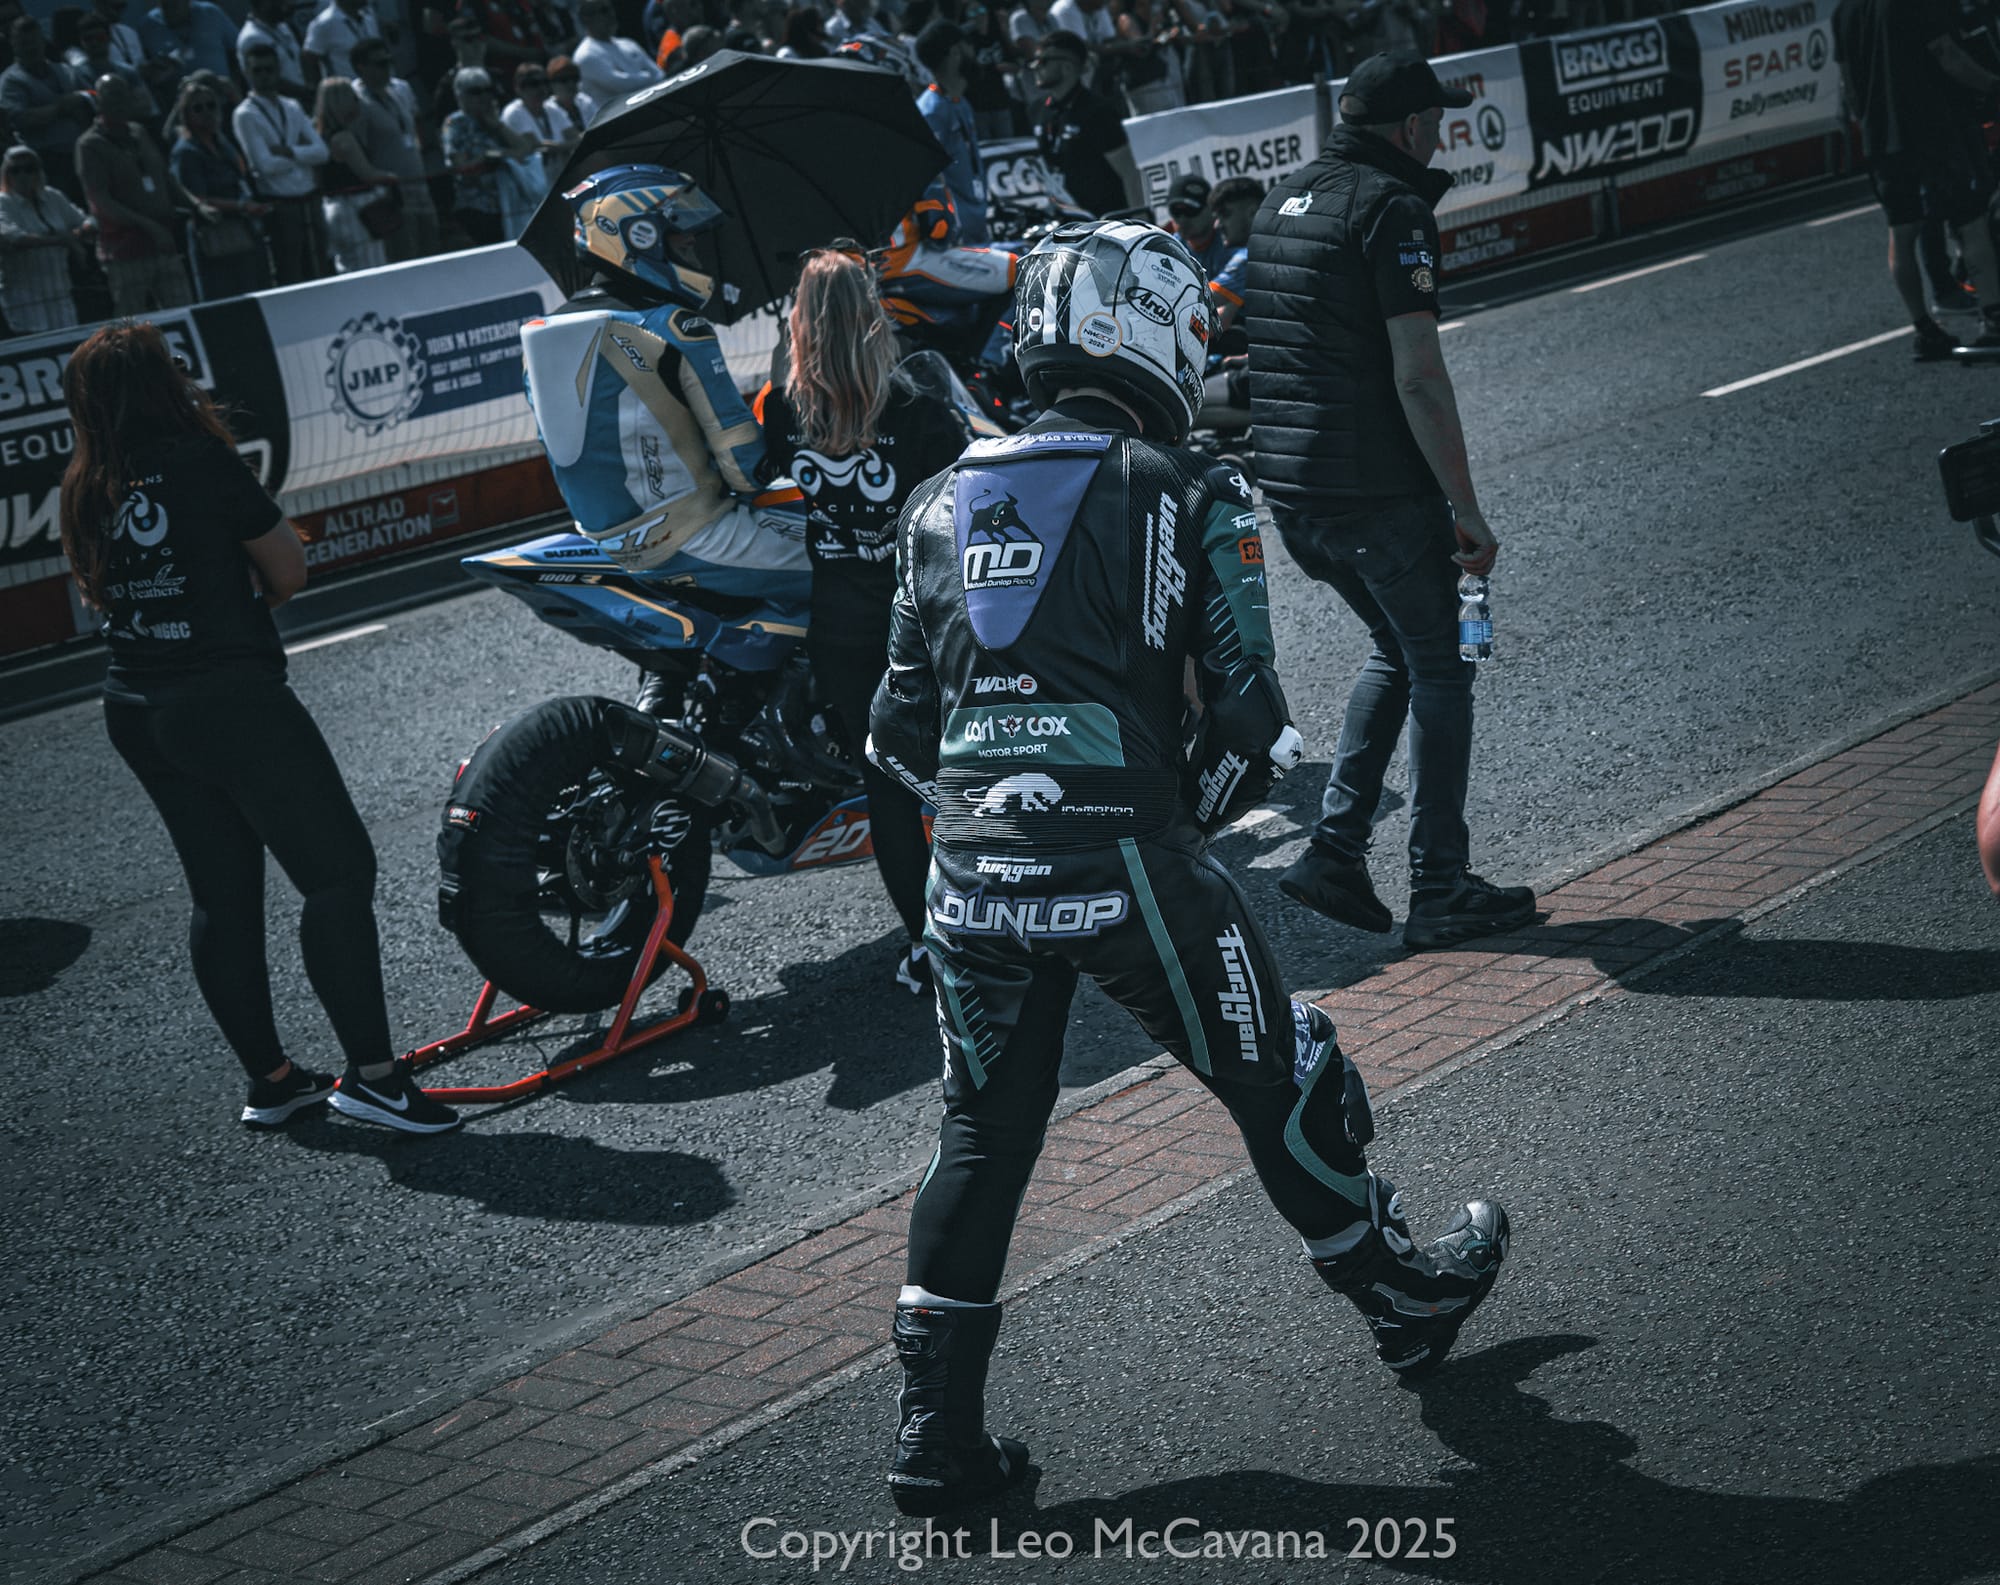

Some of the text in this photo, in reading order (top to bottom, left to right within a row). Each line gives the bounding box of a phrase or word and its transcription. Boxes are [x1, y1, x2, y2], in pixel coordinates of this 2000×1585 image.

[1559, 31, 1660, 80] BRIGGS
[1724, 43, 1803, 88] SPAR
[1211, 134, 1302, 179] FRASER
[1535, 107, 1695, 180] NW200
[1133, 292, 1171, 322] Arai
[348, 363, 400, 391] JMP
[323, 497, 406, 537] ALTRAD
[758, 517, 807, 542] RS
[303, 513, 433, 567] GENERATION
[544, 548, 600, 559] SUZUKI
[538, 573, 577, 584] 1000
[988, 579, 1012, 588] Dunlop
[1013, 577, 1035, 587] Racing
[978, 743, 1048, 759] MOTOR SPORT
[794, 818, 871, 864] 20
[934, 893, 1123, 941] DUNLOP
